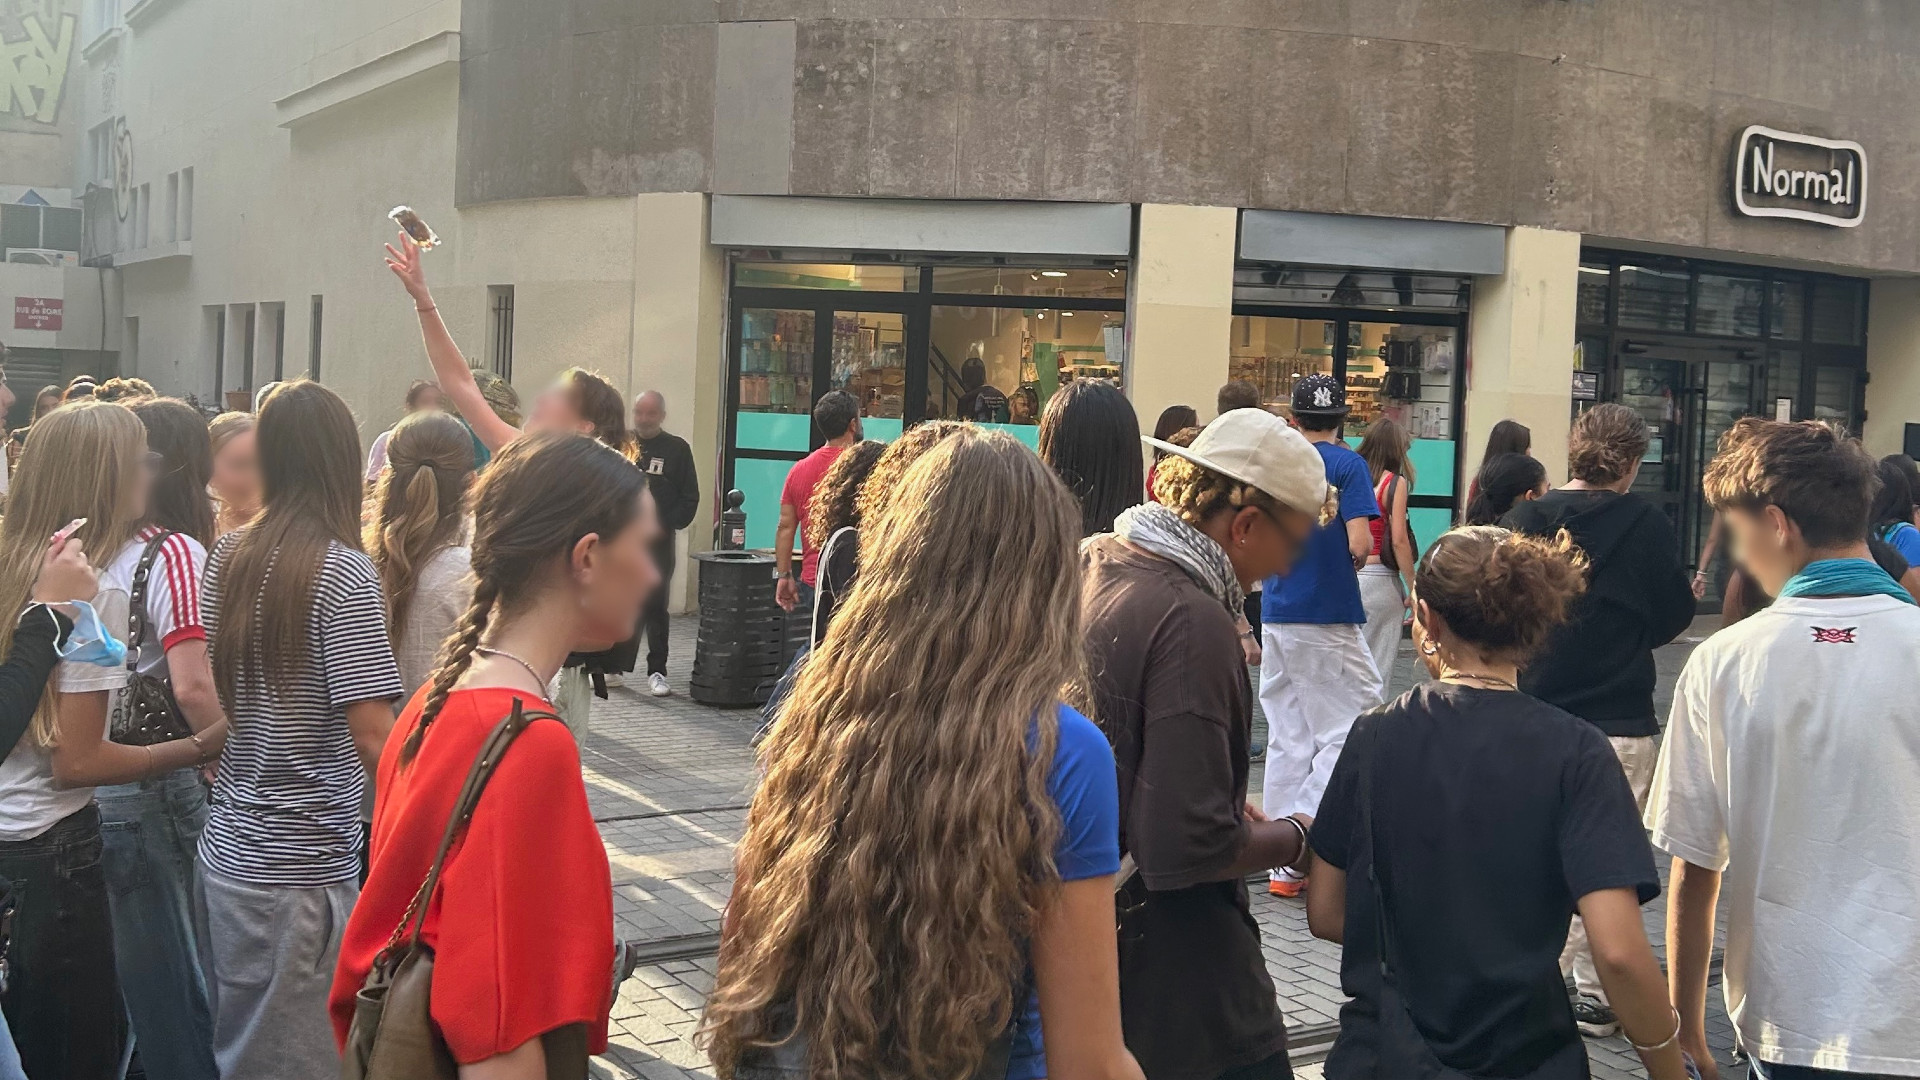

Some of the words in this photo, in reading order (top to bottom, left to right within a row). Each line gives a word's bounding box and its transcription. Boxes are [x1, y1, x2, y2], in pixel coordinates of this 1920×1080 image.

[1753, 141, 1854, 205] Normal
[16, 306, 29, 314] RUE
[31, 307, 40, 315] de
[1313, 386, 1333, 407] NY
